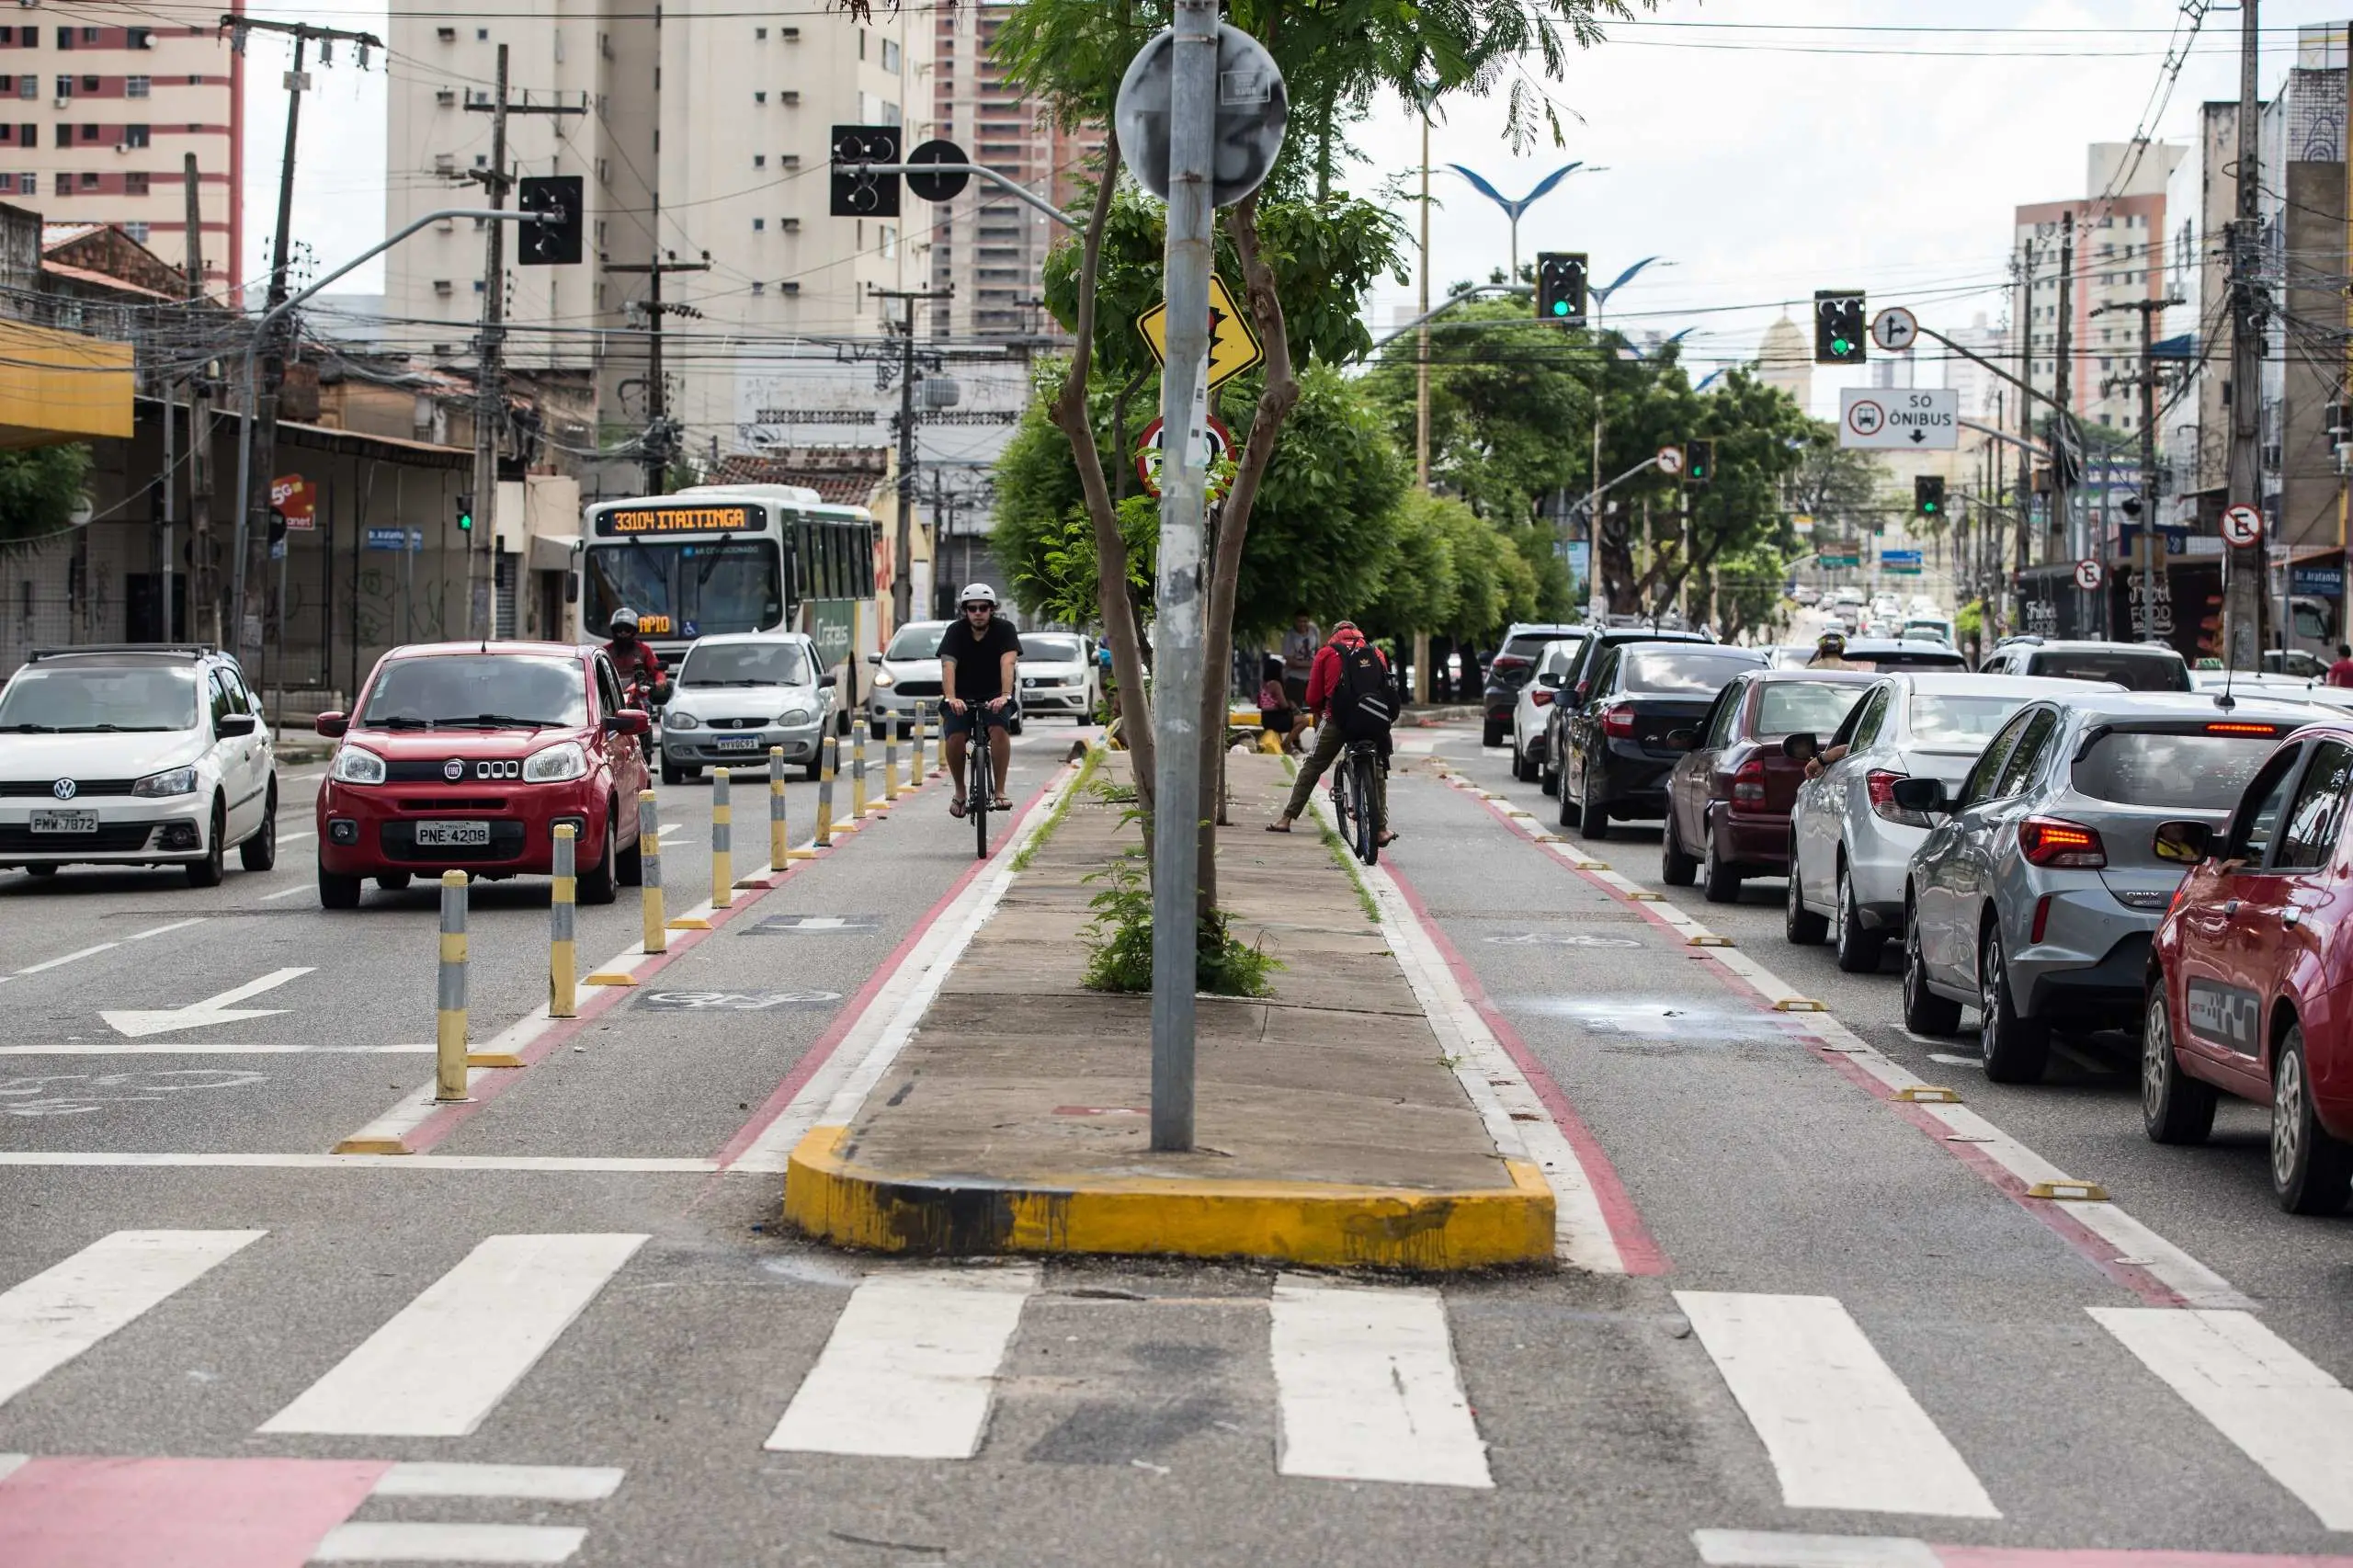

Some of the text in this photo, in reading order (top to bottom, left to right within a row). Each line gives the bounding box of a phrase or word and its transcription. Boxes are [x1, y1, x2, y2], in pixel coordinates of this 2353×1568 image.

[1910, 392, 1932, 408] SÓ
[1889, 409, 1951, 426] ÔNIBUS
[614, 508, 745, 531] 33104 ITAITINGA
[2306, 571, 2341, 583] Aratanha
